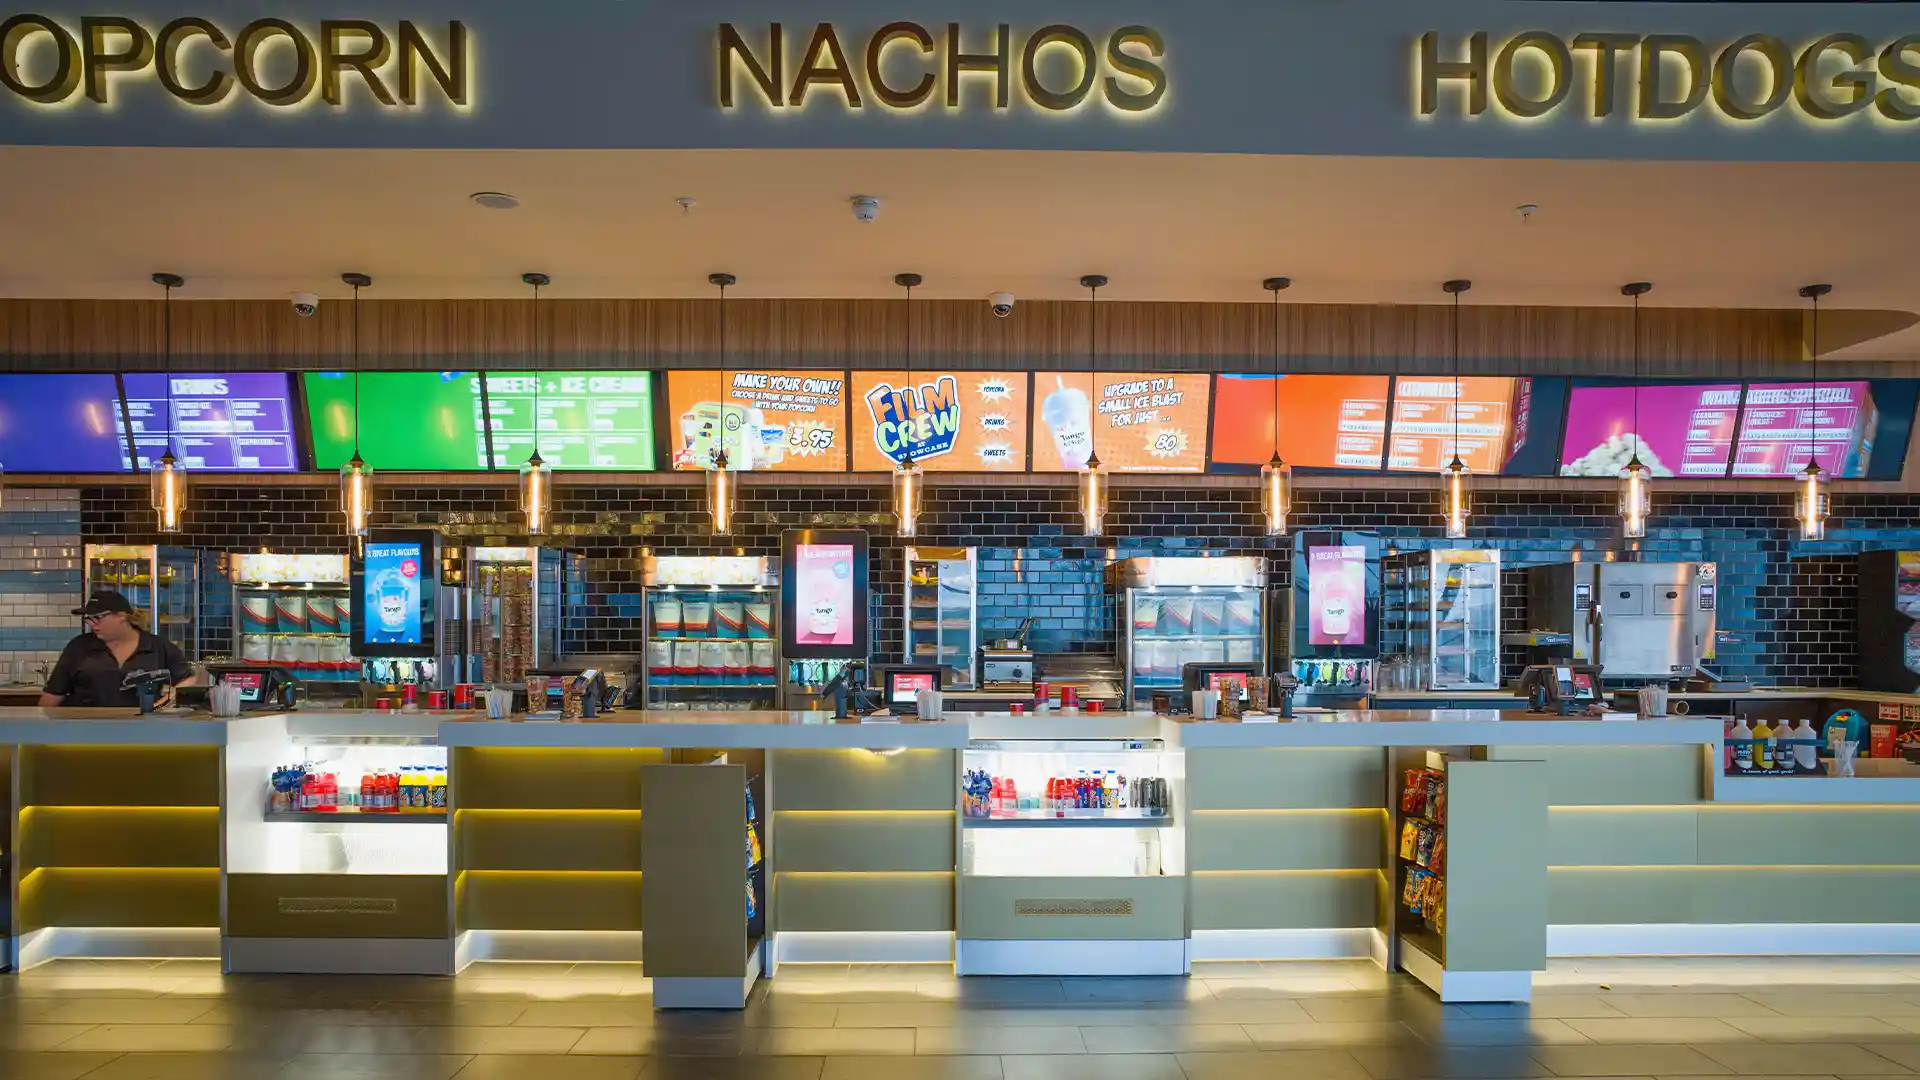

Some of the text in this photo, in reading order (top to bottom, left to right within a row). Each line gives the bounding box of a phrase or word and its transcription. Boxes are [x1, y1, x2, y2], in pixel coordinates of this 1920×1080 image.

[717, 21, 1167, 111] NACHOS
[1419, 30, 1920, 121] HOTDOGS
[732, 373, 842, 395] MAKE YOUR OWN!!
[1104, 377, 1175, 398] UPGRADE TO A
[731, 390, 757, 399] CHOOSE
[780, 394, 795, 402] AND
[819, 397, 829, 405] TO
[829, 397, 839, 406] GO
[867, 377, 955, 425] FILM
[1098, 392, 1183, 414] SMALL ICE BLAST
[877, 404, 958, 452] CREW
[984, 418, 1005, 426] DRINKS
[1111, 413, 1132, 428] FOR
[1154, 433, 1178, 451] 80
[983, 449, 1006, 457] SWEETS
[816, 607, 833, 615] Tango
[1326, 608, 1345, 616] Tango
